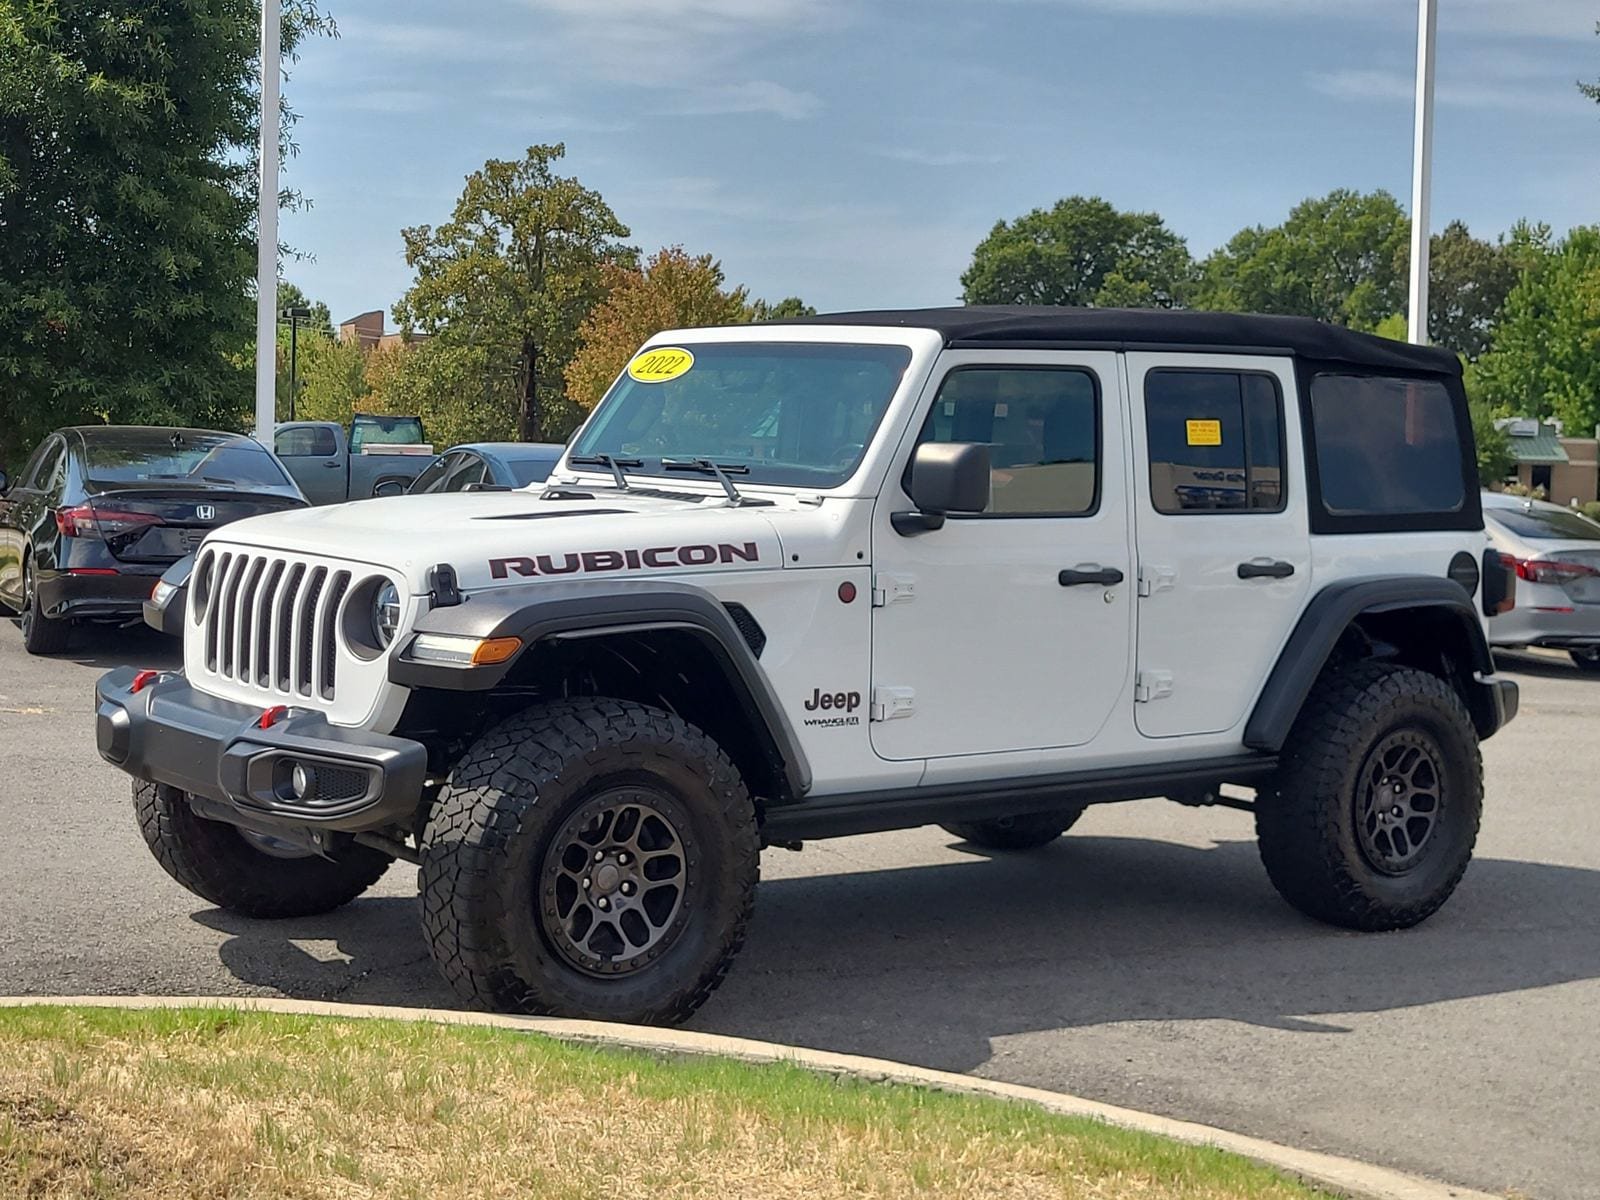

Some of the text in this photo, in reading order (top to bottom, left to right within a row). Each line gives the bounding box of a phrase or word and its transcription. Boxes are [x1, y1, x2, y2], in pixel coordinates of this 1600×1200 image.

[635, 355, 686, 375] 2022
[488, 541, 760, 579] RUBICON
[804, 687, 861, 713] Jeep
